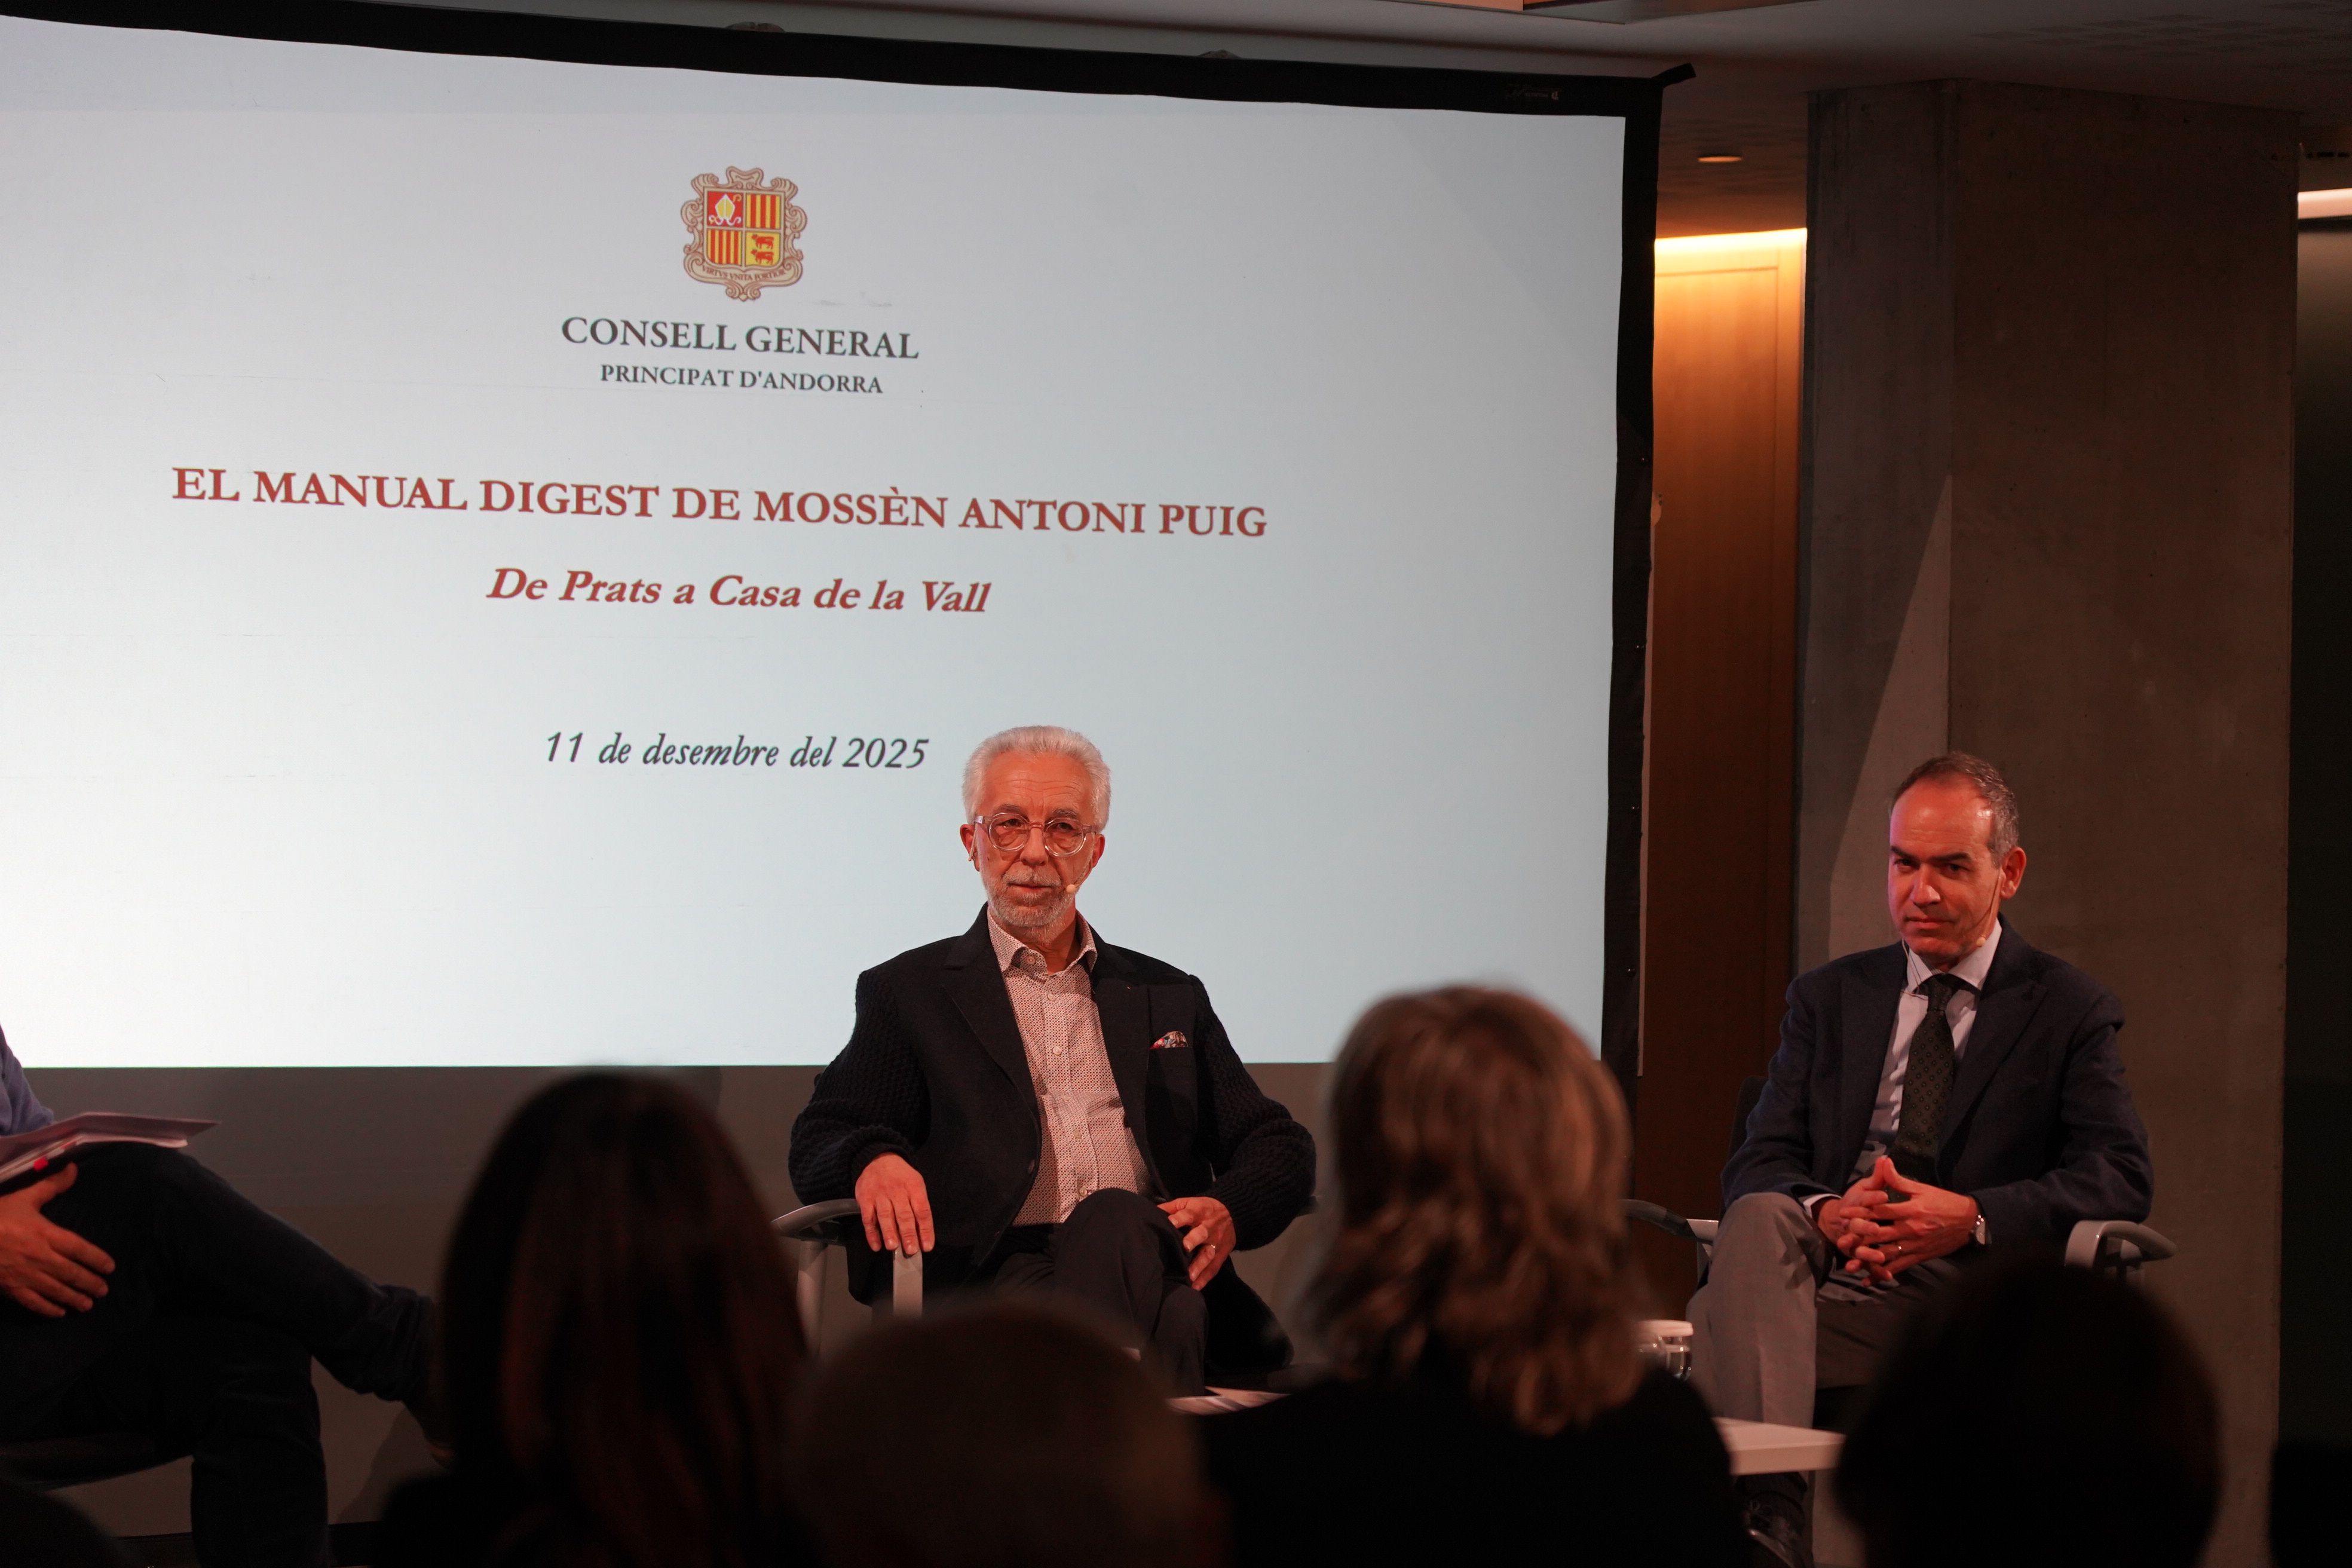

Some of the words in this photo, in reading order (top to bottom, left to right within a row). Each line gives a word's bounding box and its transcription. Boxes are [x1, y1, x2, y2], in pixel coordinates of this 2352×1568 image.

[561, 316, 737, 351] CONSELL
[745, 325, 920, 359] GENERAL
[600, 364, 734, 387] PRINCIPAT
[739, 370, 884, 394] D'ANDORRA
[172, 467, 241, 502] EL
[252, 470, 468, 511] MANUAL
[479, 479, 660, 518] DIGEST
[671, 486, 741, 521] DE
[752, 485, 949, 529] MOSSÈN
[957, 497, 1147, 534] ANTONI
[1158, 503, 1267, 538] PUIG
[485, 566, 549, 601] De
[558, 569, 663, 604] Prats
[672, 583, 696, 605] a
[709, 574, 802, 608] Casa
[813, 577, 862, 610] de
[867, 579, 905, 611] la
[921, 580, 992, 612] Vall
[546, 731, 584, 763] 11
[598, 731, 632, 765] de
[642, 732, 780, 767] desembre
[789, 735, 838, 768] del
[842, 737, 930, 770] 2025
